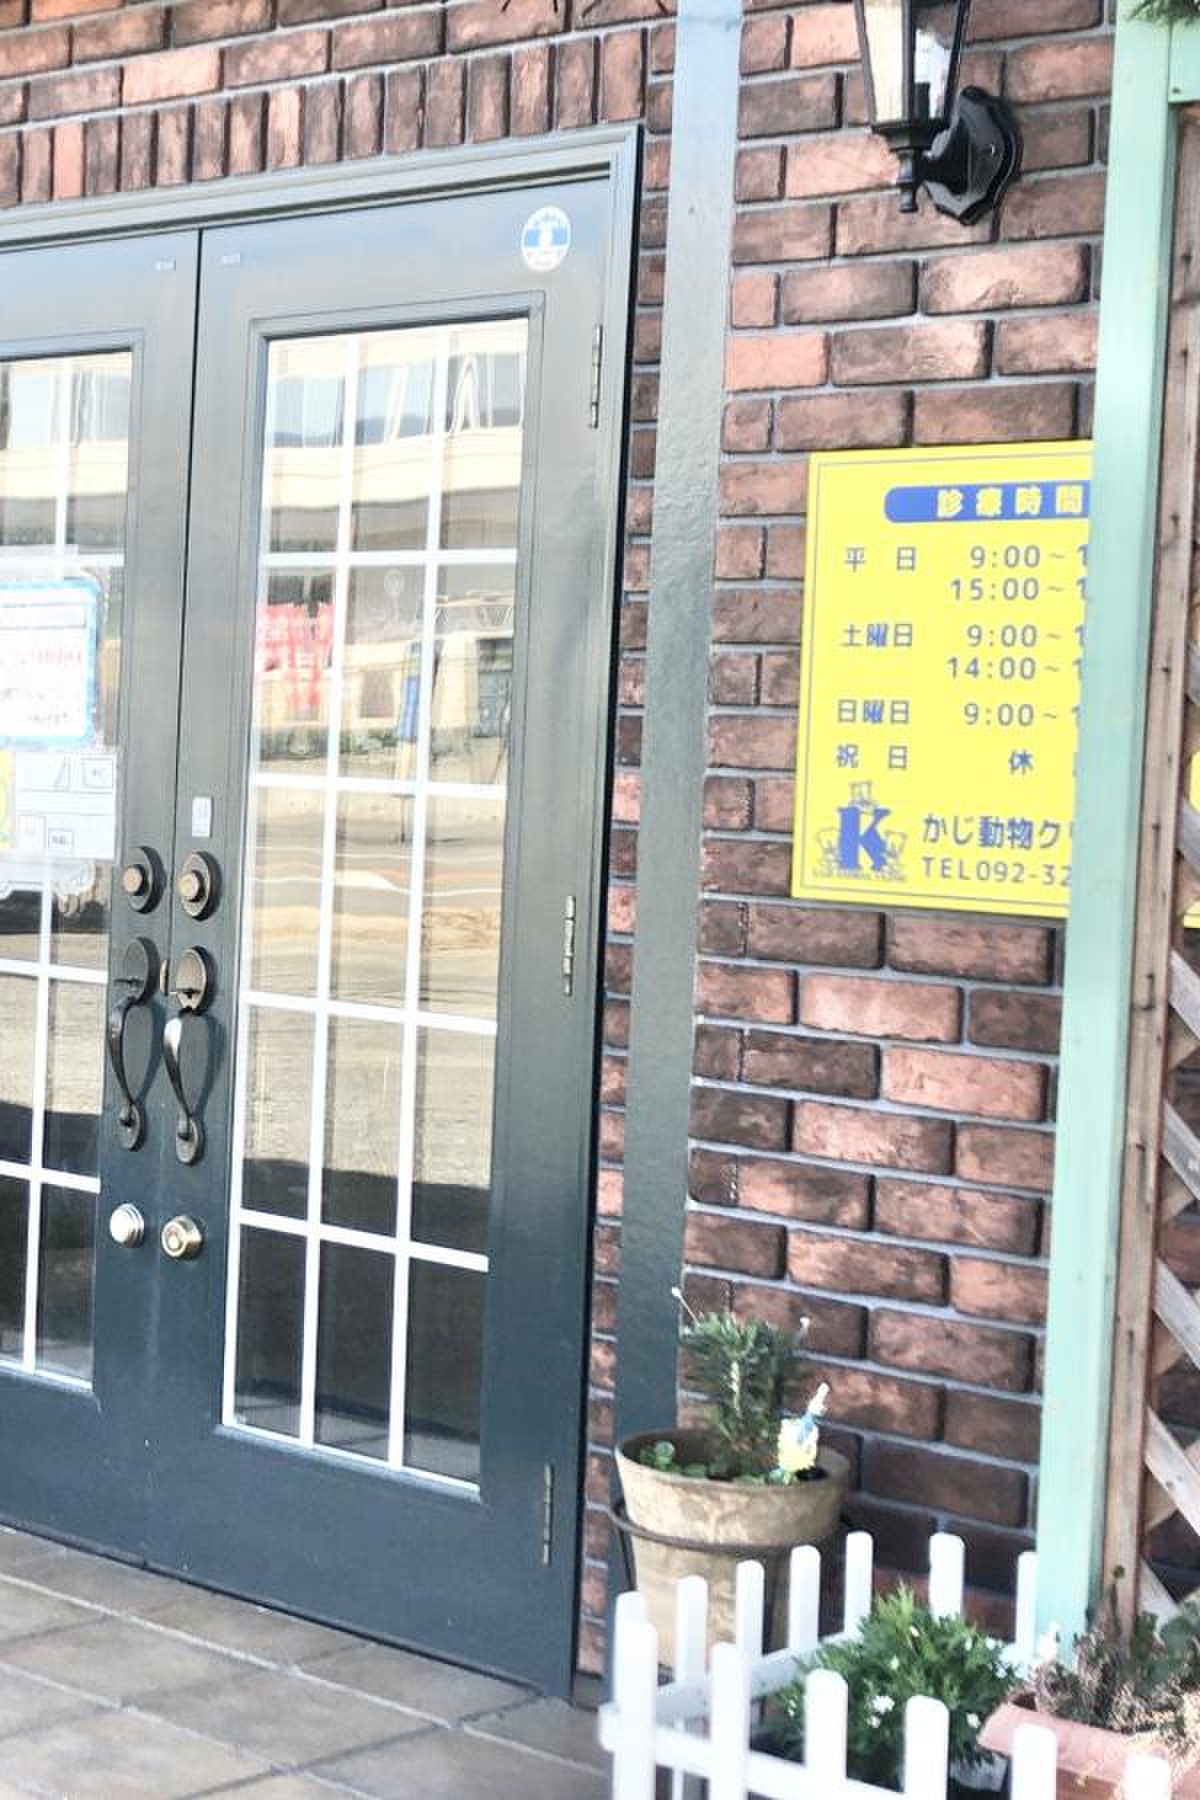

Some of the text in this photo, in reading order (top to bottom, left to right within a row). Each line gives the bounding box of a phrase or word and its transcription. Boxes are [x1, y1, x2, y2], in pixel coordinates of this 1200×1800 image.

[936, 485, 1084, 519] 診療時間
[842, 623, 914, 648] 土曜日
[837, 699, 911, 725] 日曜日
[922, 815, 1075, 851] かじ動物ク
